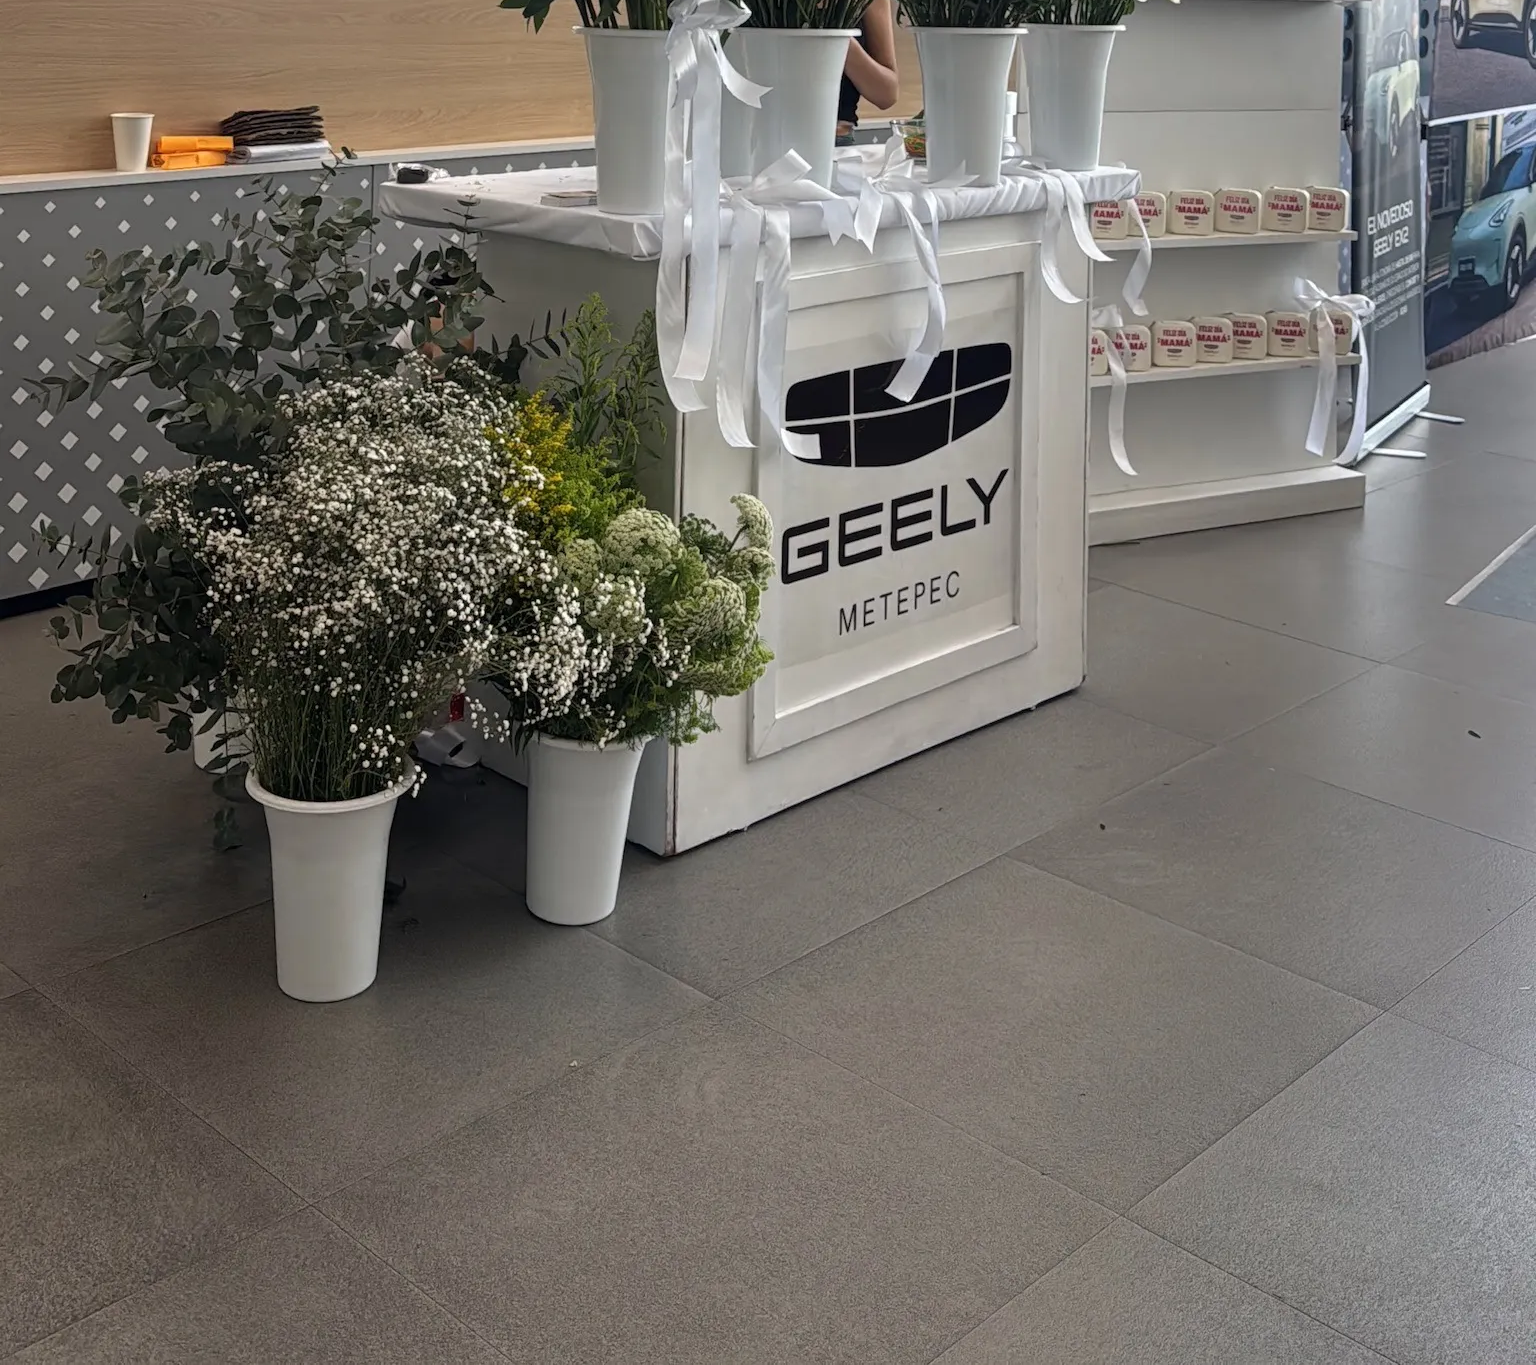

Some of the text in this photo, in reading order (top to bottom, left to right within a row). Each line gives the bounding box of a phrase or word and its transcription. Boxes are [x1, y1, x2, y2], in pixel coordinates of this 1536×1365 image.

[1181, 197, 1195, 205] FELIZ
[1226, 195, 1240, 204] FELIZ
[1313, 193, 1326, 201] FELIZ
[1178, 205, 1208, 215] MAMÁ
[1223, 203, 1254, 214] MAMÁ
[1271, 202, 1301, 212] MAMÁ
[1310, 201, 1340, 211] MAMÁ
[1138, 208, 1159, 217] AMÁ
[1277, 319, 1291, 327] FELIZ
[1163, 329, 1177, 337] FELIZ
[1199, 325, 1214, 333] FELIZ
[1274, 327, 1304, 337] MAMÁ
[1160, 337, 1191, 347] MAMÁ
[1197, 333, 1227, 343] MAMÁ
[781, 468, 1009, 585] GEELY
[838, 571, 960, 636] METEPEC
